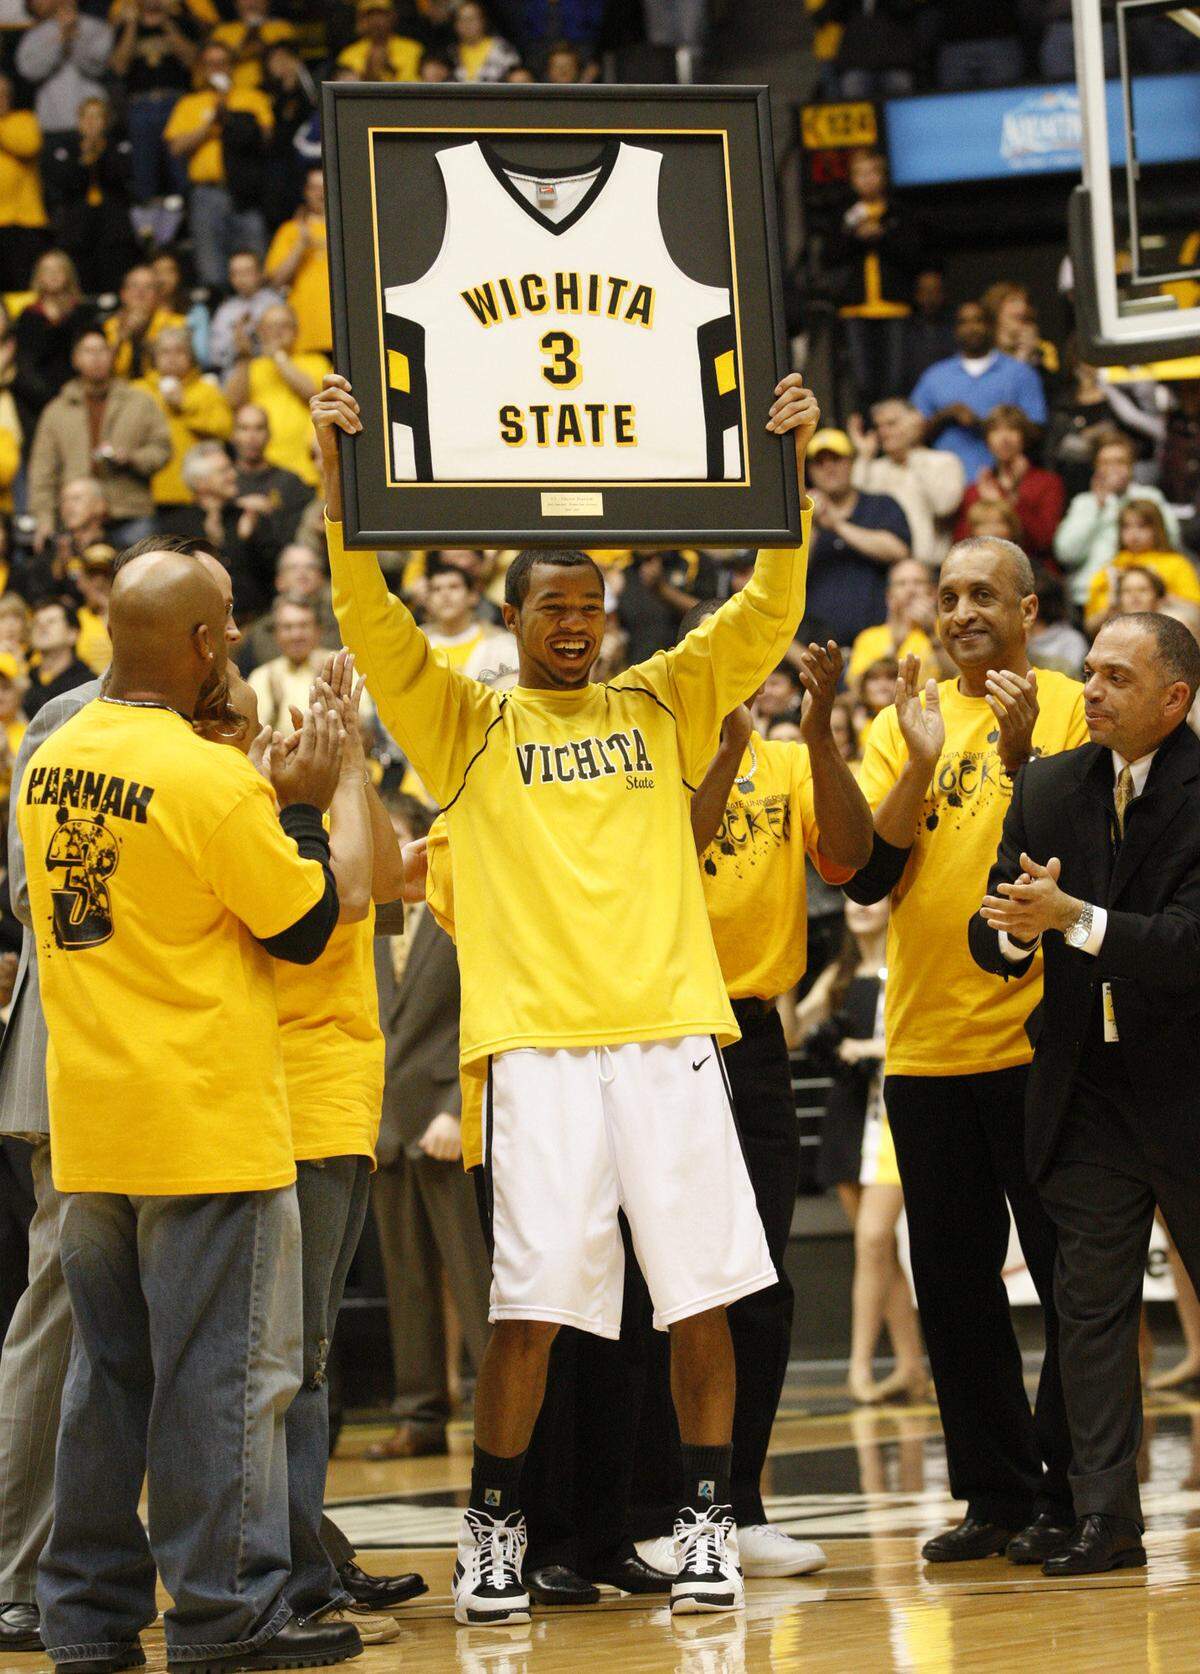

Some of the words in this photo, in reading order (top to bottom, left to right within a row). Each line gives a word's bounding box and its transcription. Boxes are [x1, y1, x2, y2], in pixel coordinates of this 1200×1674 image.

[460, 272, 656, 330] WICHITA
[539, 329, 583, 390] 3
[499, 403, 638, 448] STATE
[26, 766, 155, 825] HANNAH
[625, 775, 655, 790] State
